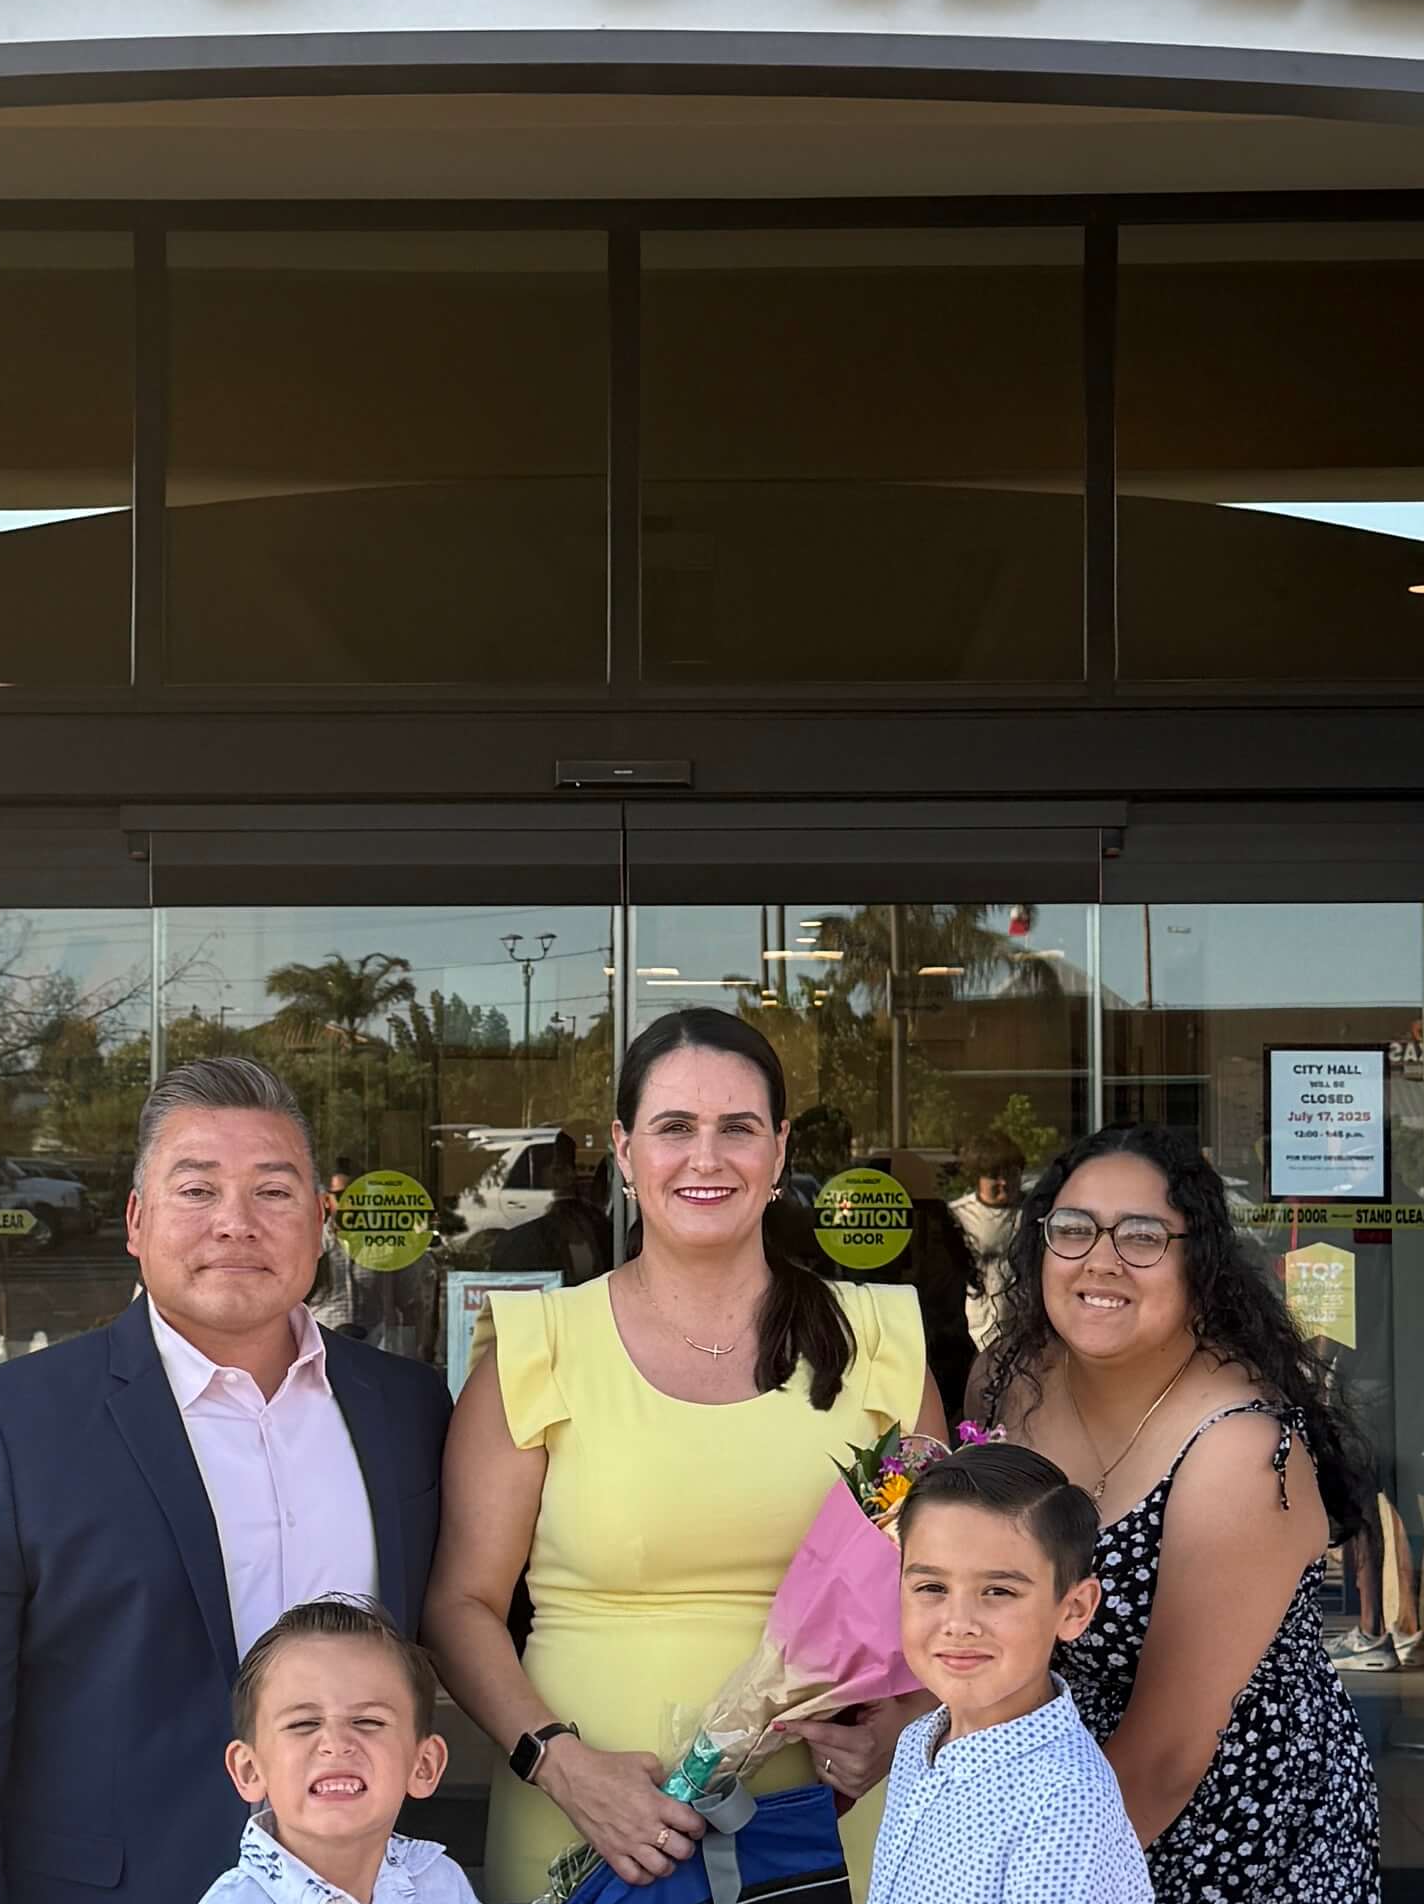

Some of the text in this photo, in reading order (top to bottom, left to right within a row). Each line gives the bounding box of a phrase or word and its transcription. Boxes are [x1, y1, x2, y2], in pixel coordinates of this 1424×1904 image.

[1292, 1063, 1362, 1075] CITY HALL
[1300, 1093, 1354, 1105] CLOSED
[1287, 1111, 1313, 1124] July
[1337, 1111, 1371, 1122] 2025
[349, 1194, 425, 1207] AUTOMATIC
[341, 1211, 428, 1230] CAUTION
[819, 1209, 907, 1227] CAUTION
[1296, 1208, 1328, 1223] DOOR
[1355, 1208, 1392, 1223] STAND
[364, 1235, 406, 1247] DOOR
[842, 1232, 885, 1245] DOOR
[1295, 1262, 1345, 1281] TOP
